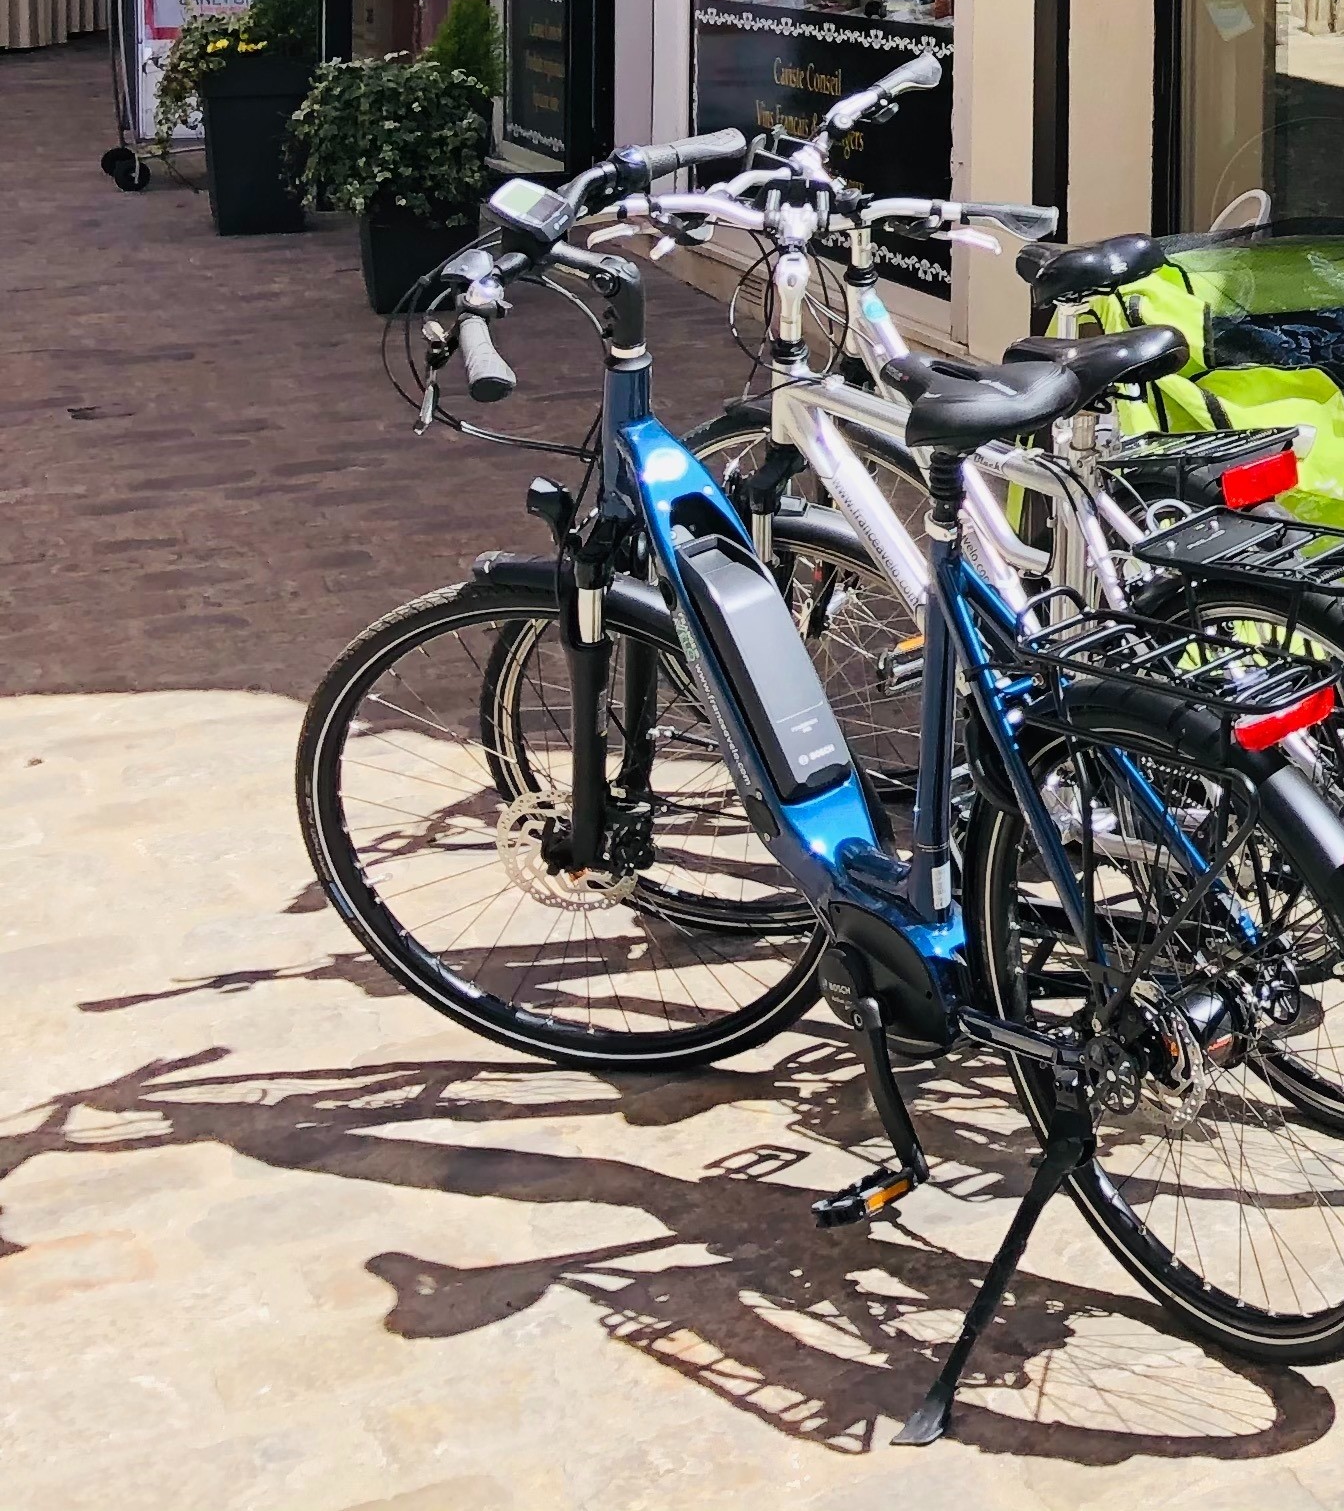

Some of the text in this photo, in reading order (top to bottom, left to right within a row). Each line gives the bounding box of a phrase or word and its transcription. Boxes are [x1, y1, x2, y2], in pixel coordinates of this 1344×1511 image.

[756, 99, 774, 128] Vins
[773, 56, 842, 97] Caviste Conseil
[831, 477, 919, 607] www.franceavelo.com
[695, 663, 751, 787] www.franceavelo.com
